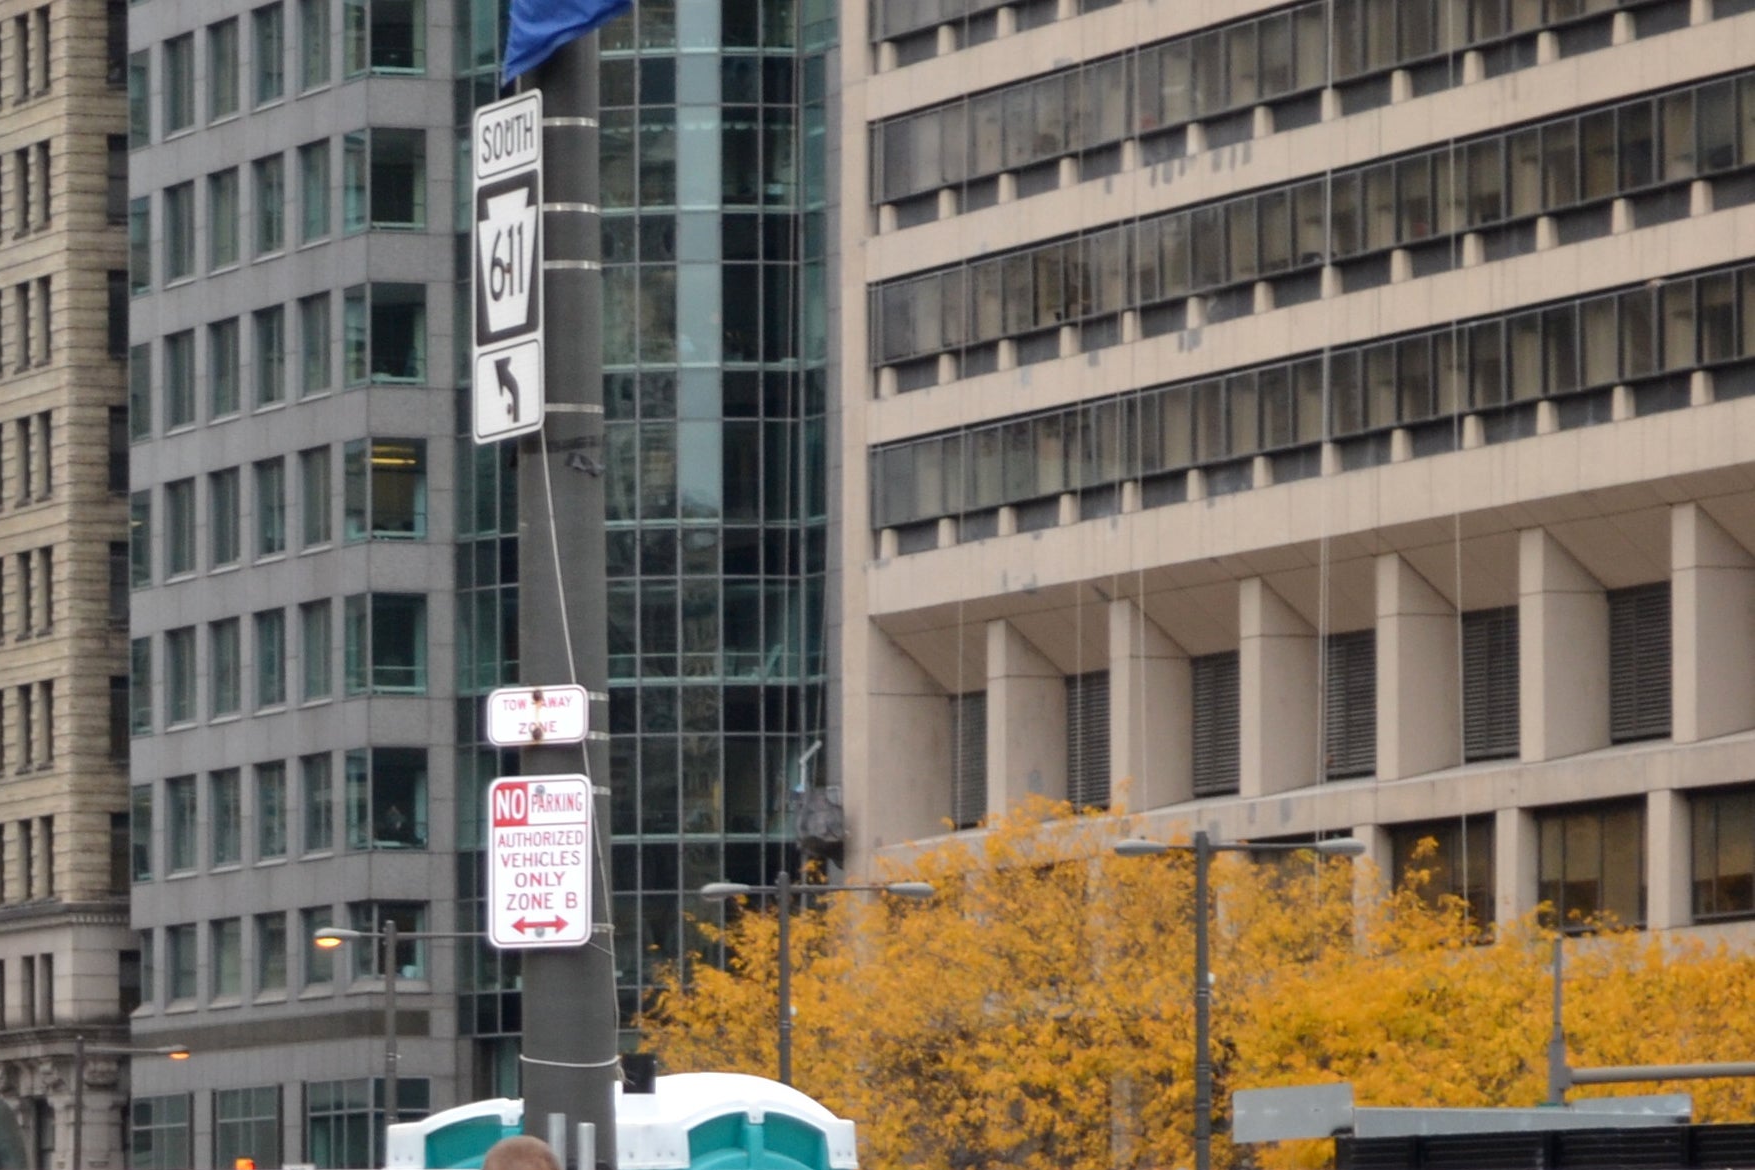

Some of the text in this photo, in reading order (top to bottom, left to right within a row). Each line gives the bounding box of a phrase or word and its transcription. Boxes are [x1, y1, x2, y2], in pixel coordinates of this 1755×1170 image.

[482, 109, 534, 164] SOUTH
[489, 222, 524, 302] 611
[503, 698, 527, 711] TOW
[540, 695, 573, 708] AWAY
[518, 721, 557, 735] ZONE
[495, 788, 583, 820] NO PARKING
[498, 830, 583, 848] AUTHORIZED
[501, 850, 581, 868] VEHICLES
[514, 871, 565, 888] ONLY
[506, 892, 578, 911] ZONE B
